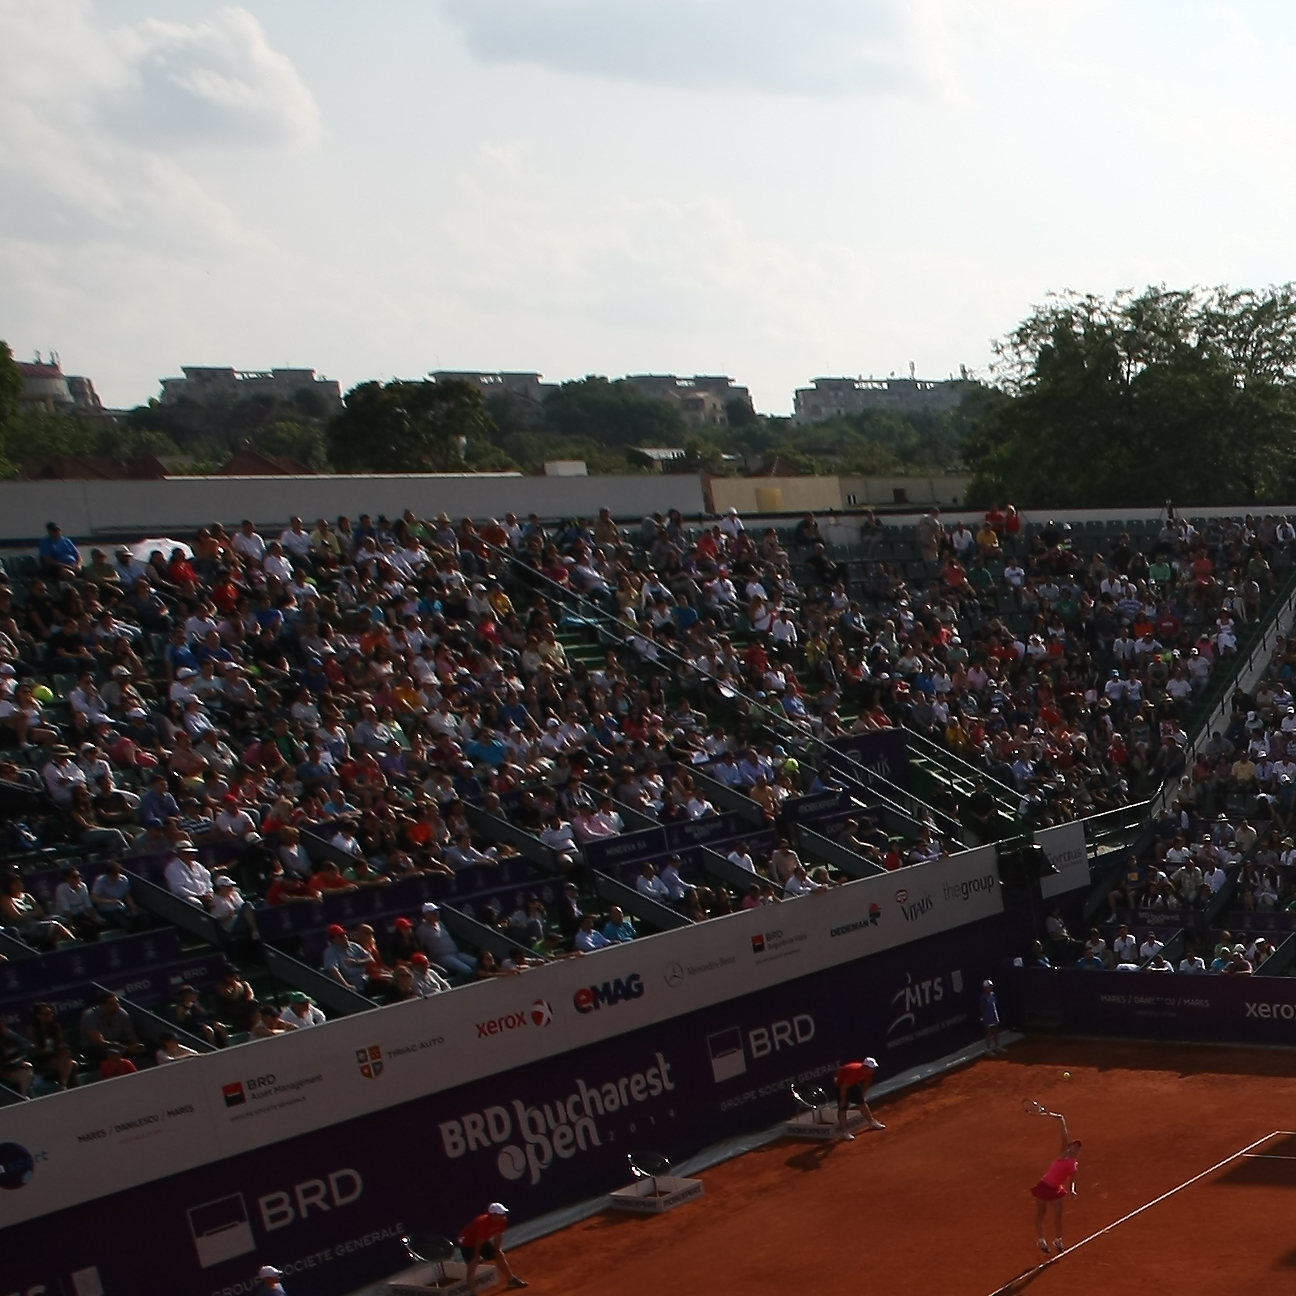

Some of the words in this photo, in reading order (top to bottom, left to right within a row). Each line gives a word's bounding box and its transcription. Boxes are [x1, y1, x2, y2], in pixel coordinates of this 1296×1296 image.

[942, 873, 995, 900] thegroup
[830, 918, 869, 938] DEDEMAN
[573, 973, 645, 1014] eMAG
[475, 1010, 527, 1038] xerox
[748, 1013, 816, 1059] BRD
[419, 1036, 445, 1051] AUTO
[247, 1073, 277, 1091] BRD
[438, 1105, 513, 1159] BRD
[511, 1052, 676, 1143] bucharest
[258, 1168, 364, 1232] BRD
[335, 1221, 407, 1258] GENERALE
